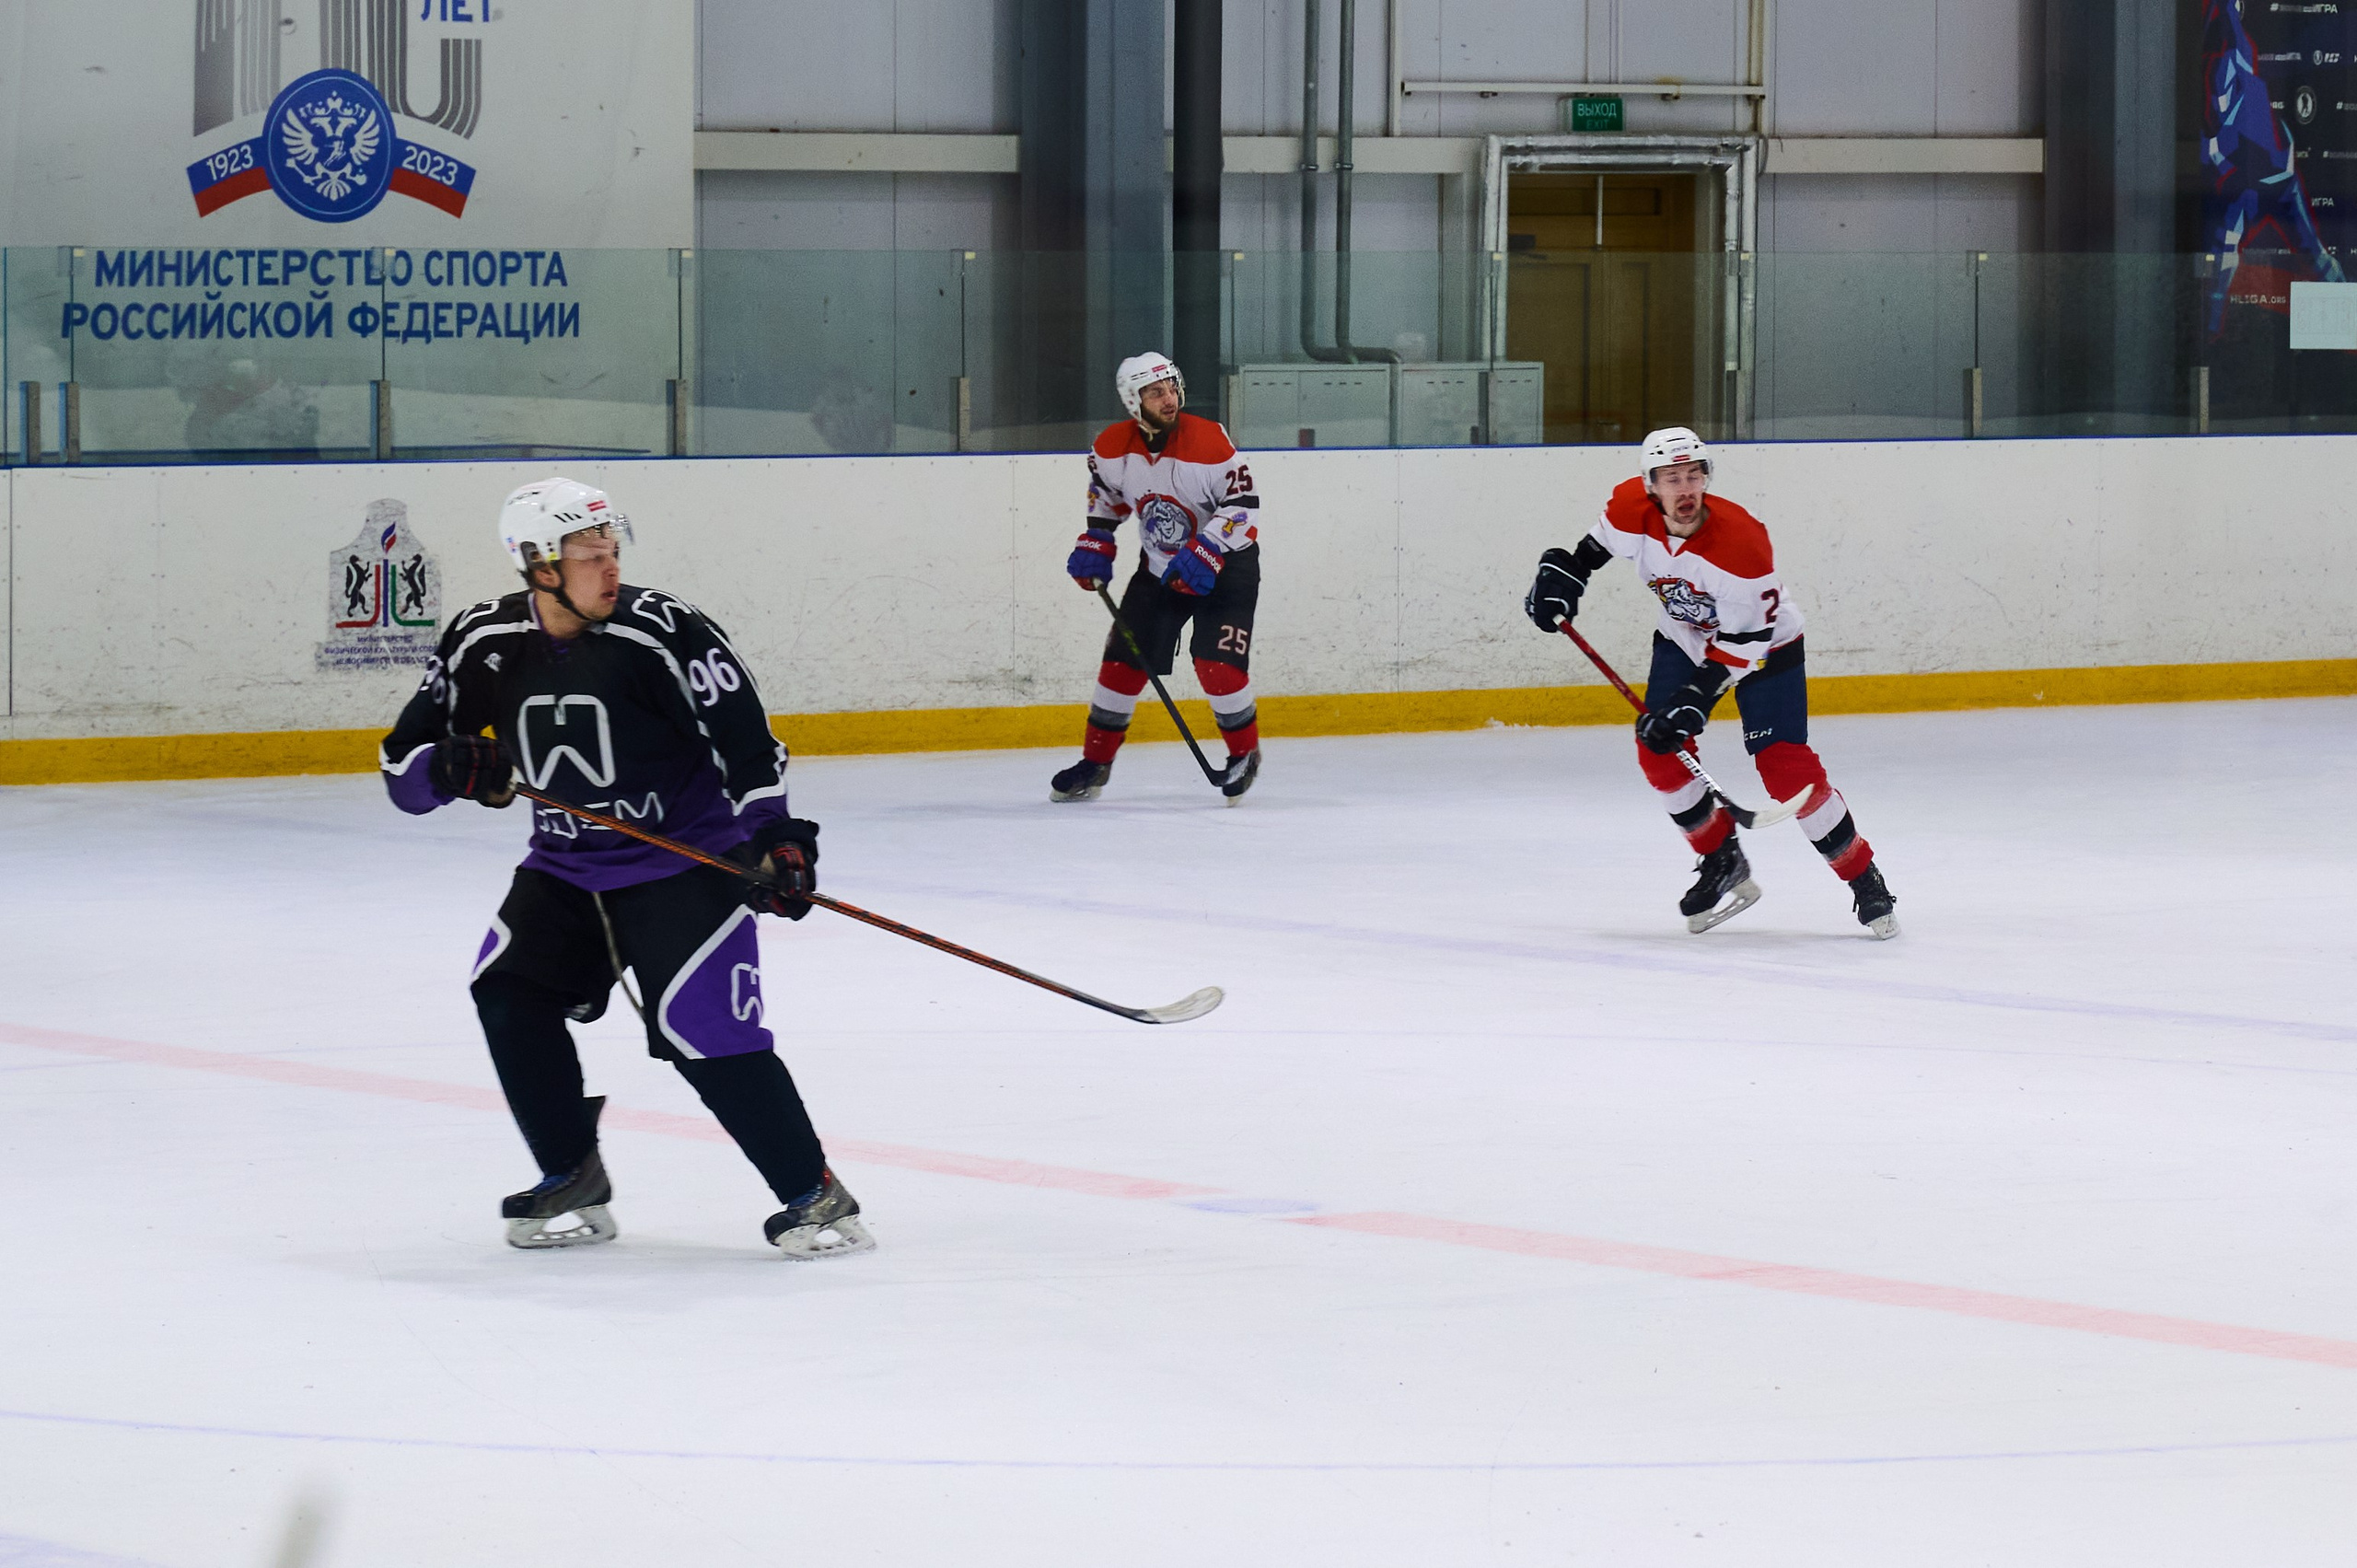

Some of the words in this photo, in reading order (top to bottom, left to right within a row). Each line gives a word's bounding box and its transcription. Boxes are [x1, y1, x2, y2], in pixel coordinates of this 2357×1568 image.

[1577, 102, 1617, 118] ВЫХОД
[1586, 119, 1609, 130] EXIT
[206, 145, 254, 181] 1923
[401, 145, 459, 186] 2023
[424, 250, 568, 287] СПОРТА
[61, 290, 333, 341] РОССИЙСКОЙ
[347, 301, 580, 344] ФЕДЕРАЦИИ
[1225, 464, 1253, 496] 25
[1194, 545, 1222, 575] Reebok
[1217, 624, 1248, 655] 25
[689, 647, 740, 707] 96
